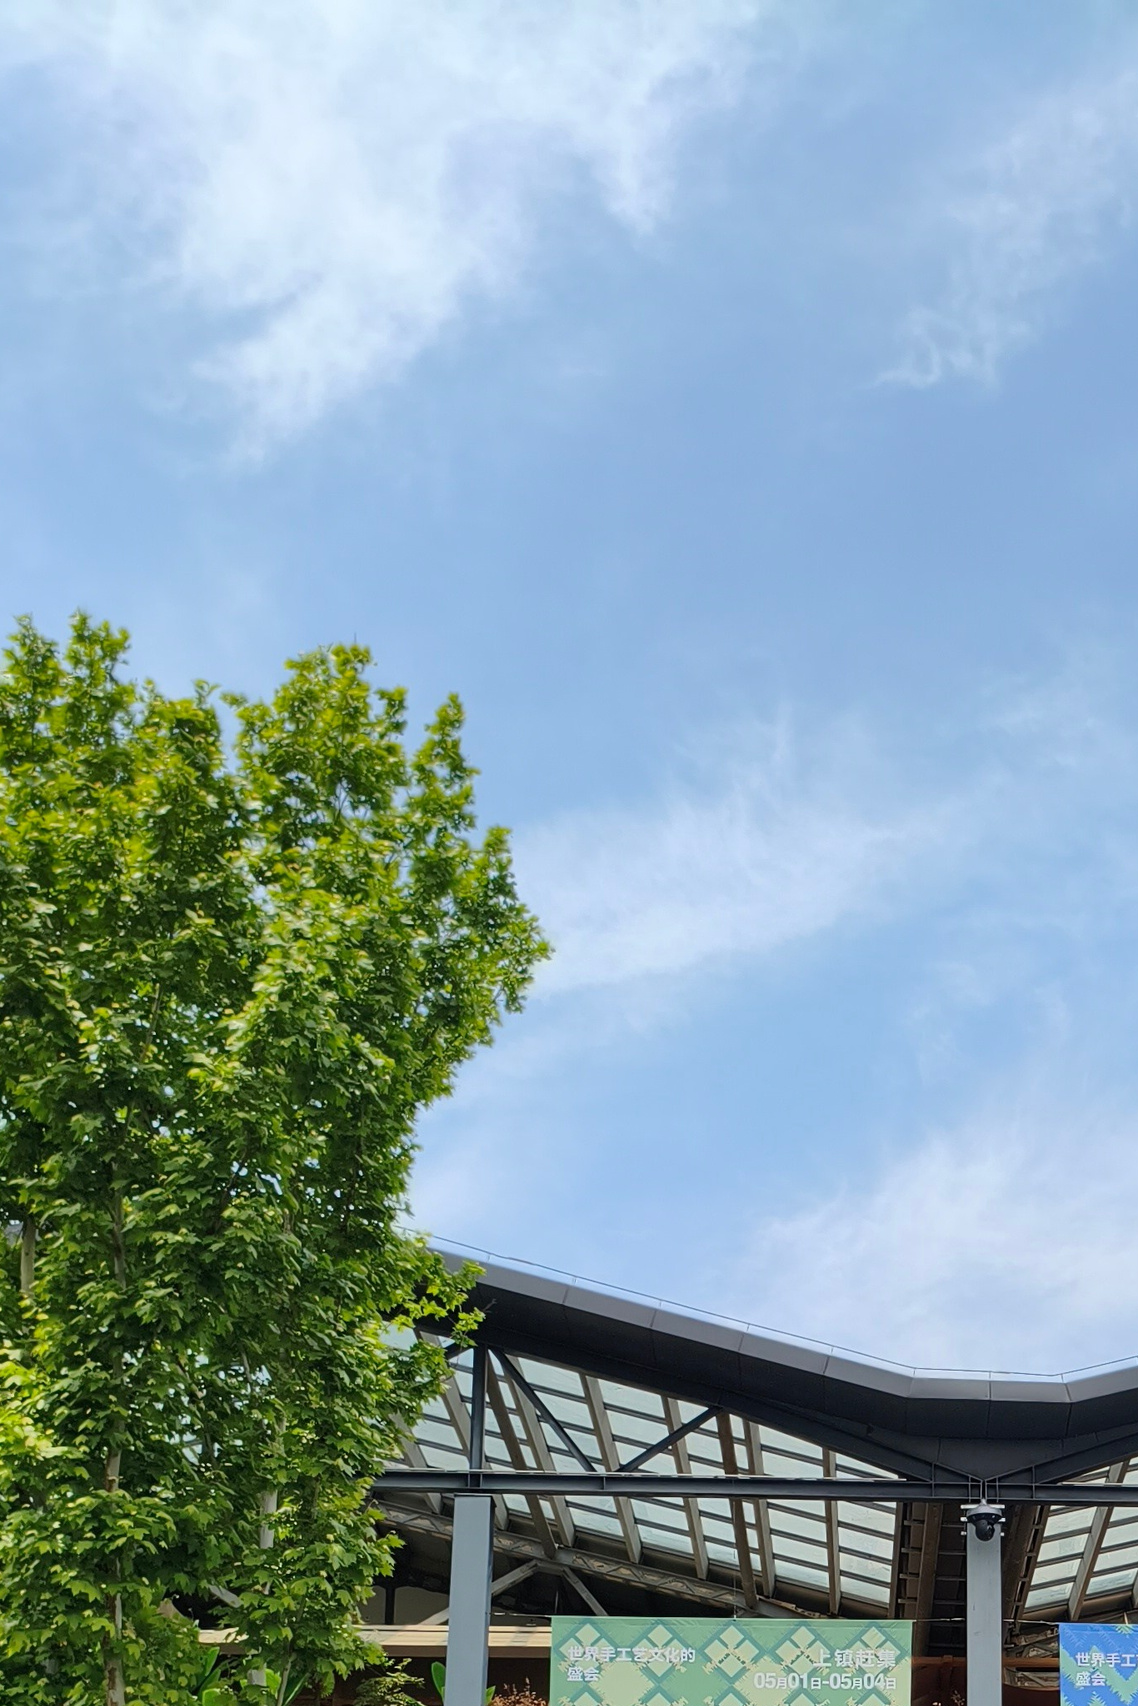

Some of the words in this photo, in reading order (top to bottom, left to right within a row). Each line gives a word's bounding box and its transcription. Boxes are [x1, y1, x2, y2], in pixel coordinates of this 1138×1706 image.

[568, 1646, 696, 1663] 世界手工艺文化的
[813, 1649, 896, 1668] 上镇赶集
[567, 1666, 600, 1681] 盛会
[754, 1672, 896, 1689] 05月01日-05月04日
[1075, 1672, 1106, 1687] 盛会
